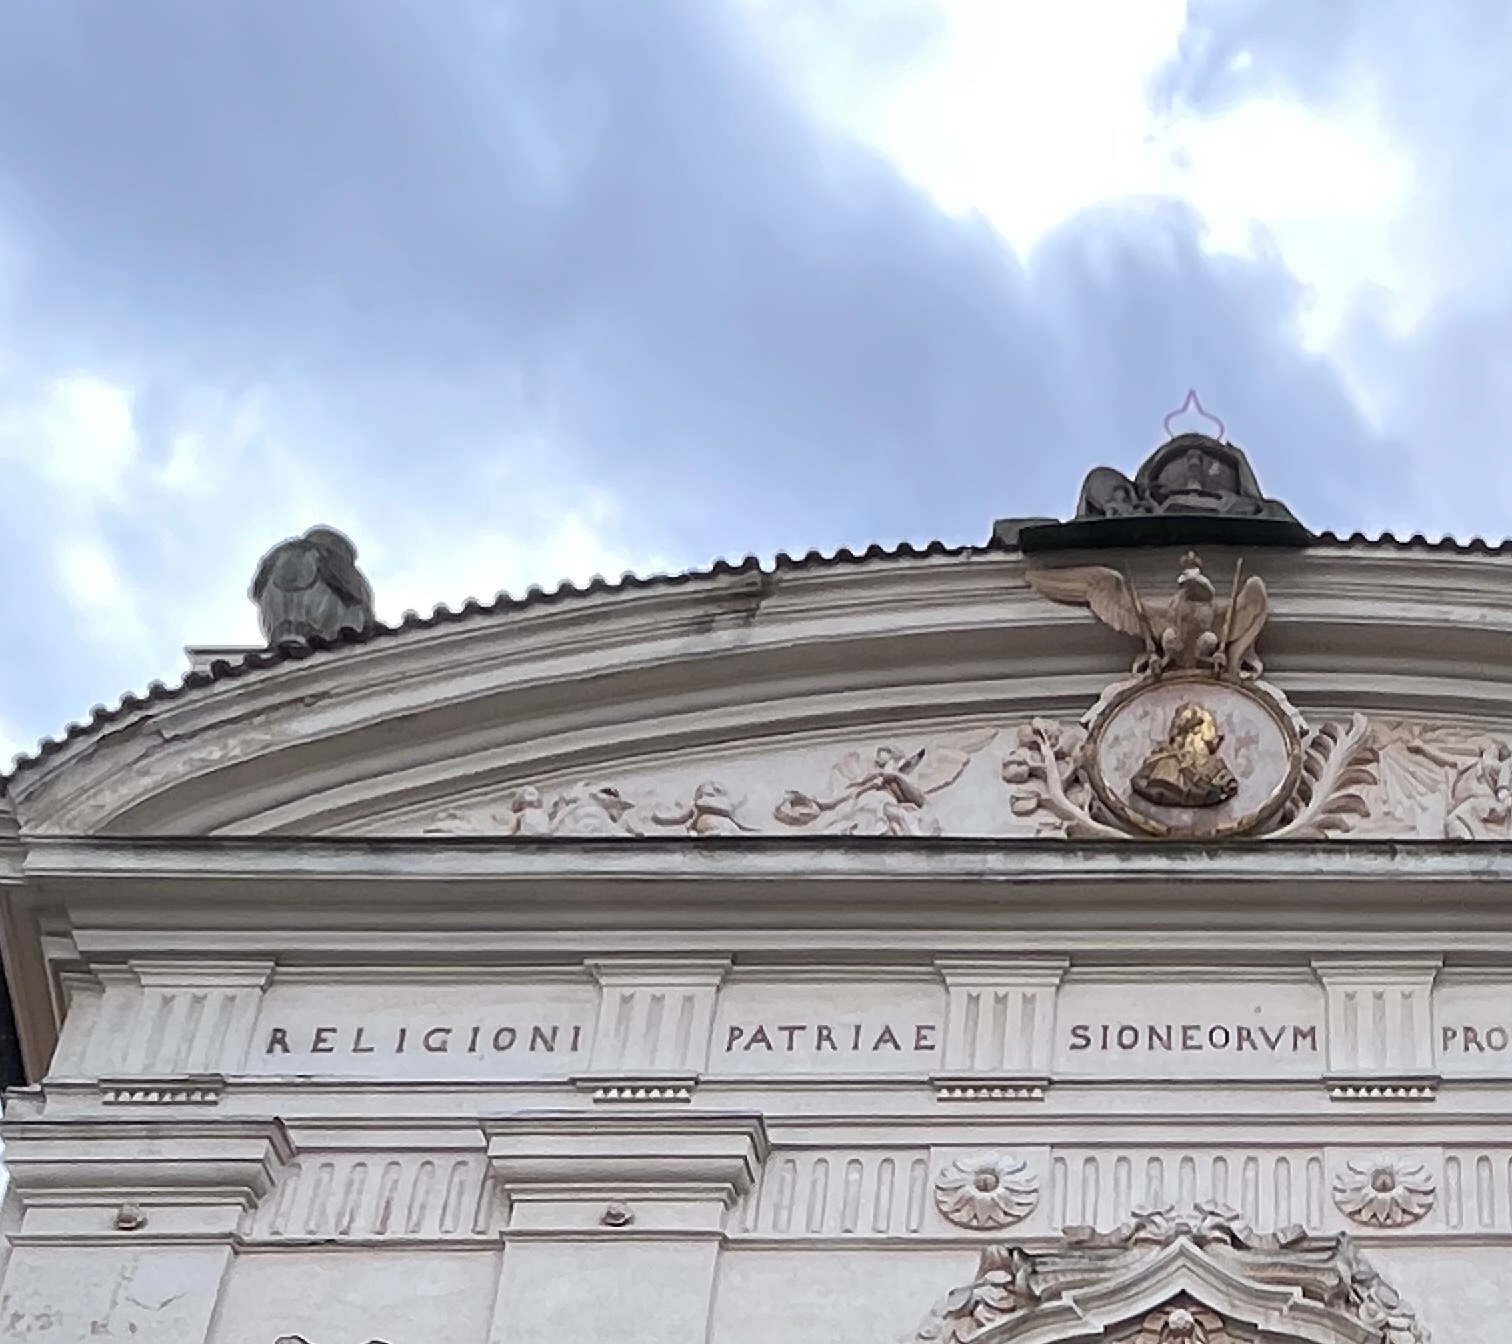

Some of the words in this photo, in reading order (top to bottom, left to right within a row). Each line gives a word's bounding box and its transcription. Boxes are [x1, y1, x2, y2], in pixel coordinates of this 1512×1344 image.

[265, 1025, 581, 1054] RELIGIONI
[726, 1023, 938, 1052] PATRIAE
[1069, 1023, 1319, 1052] SIONEORVM
